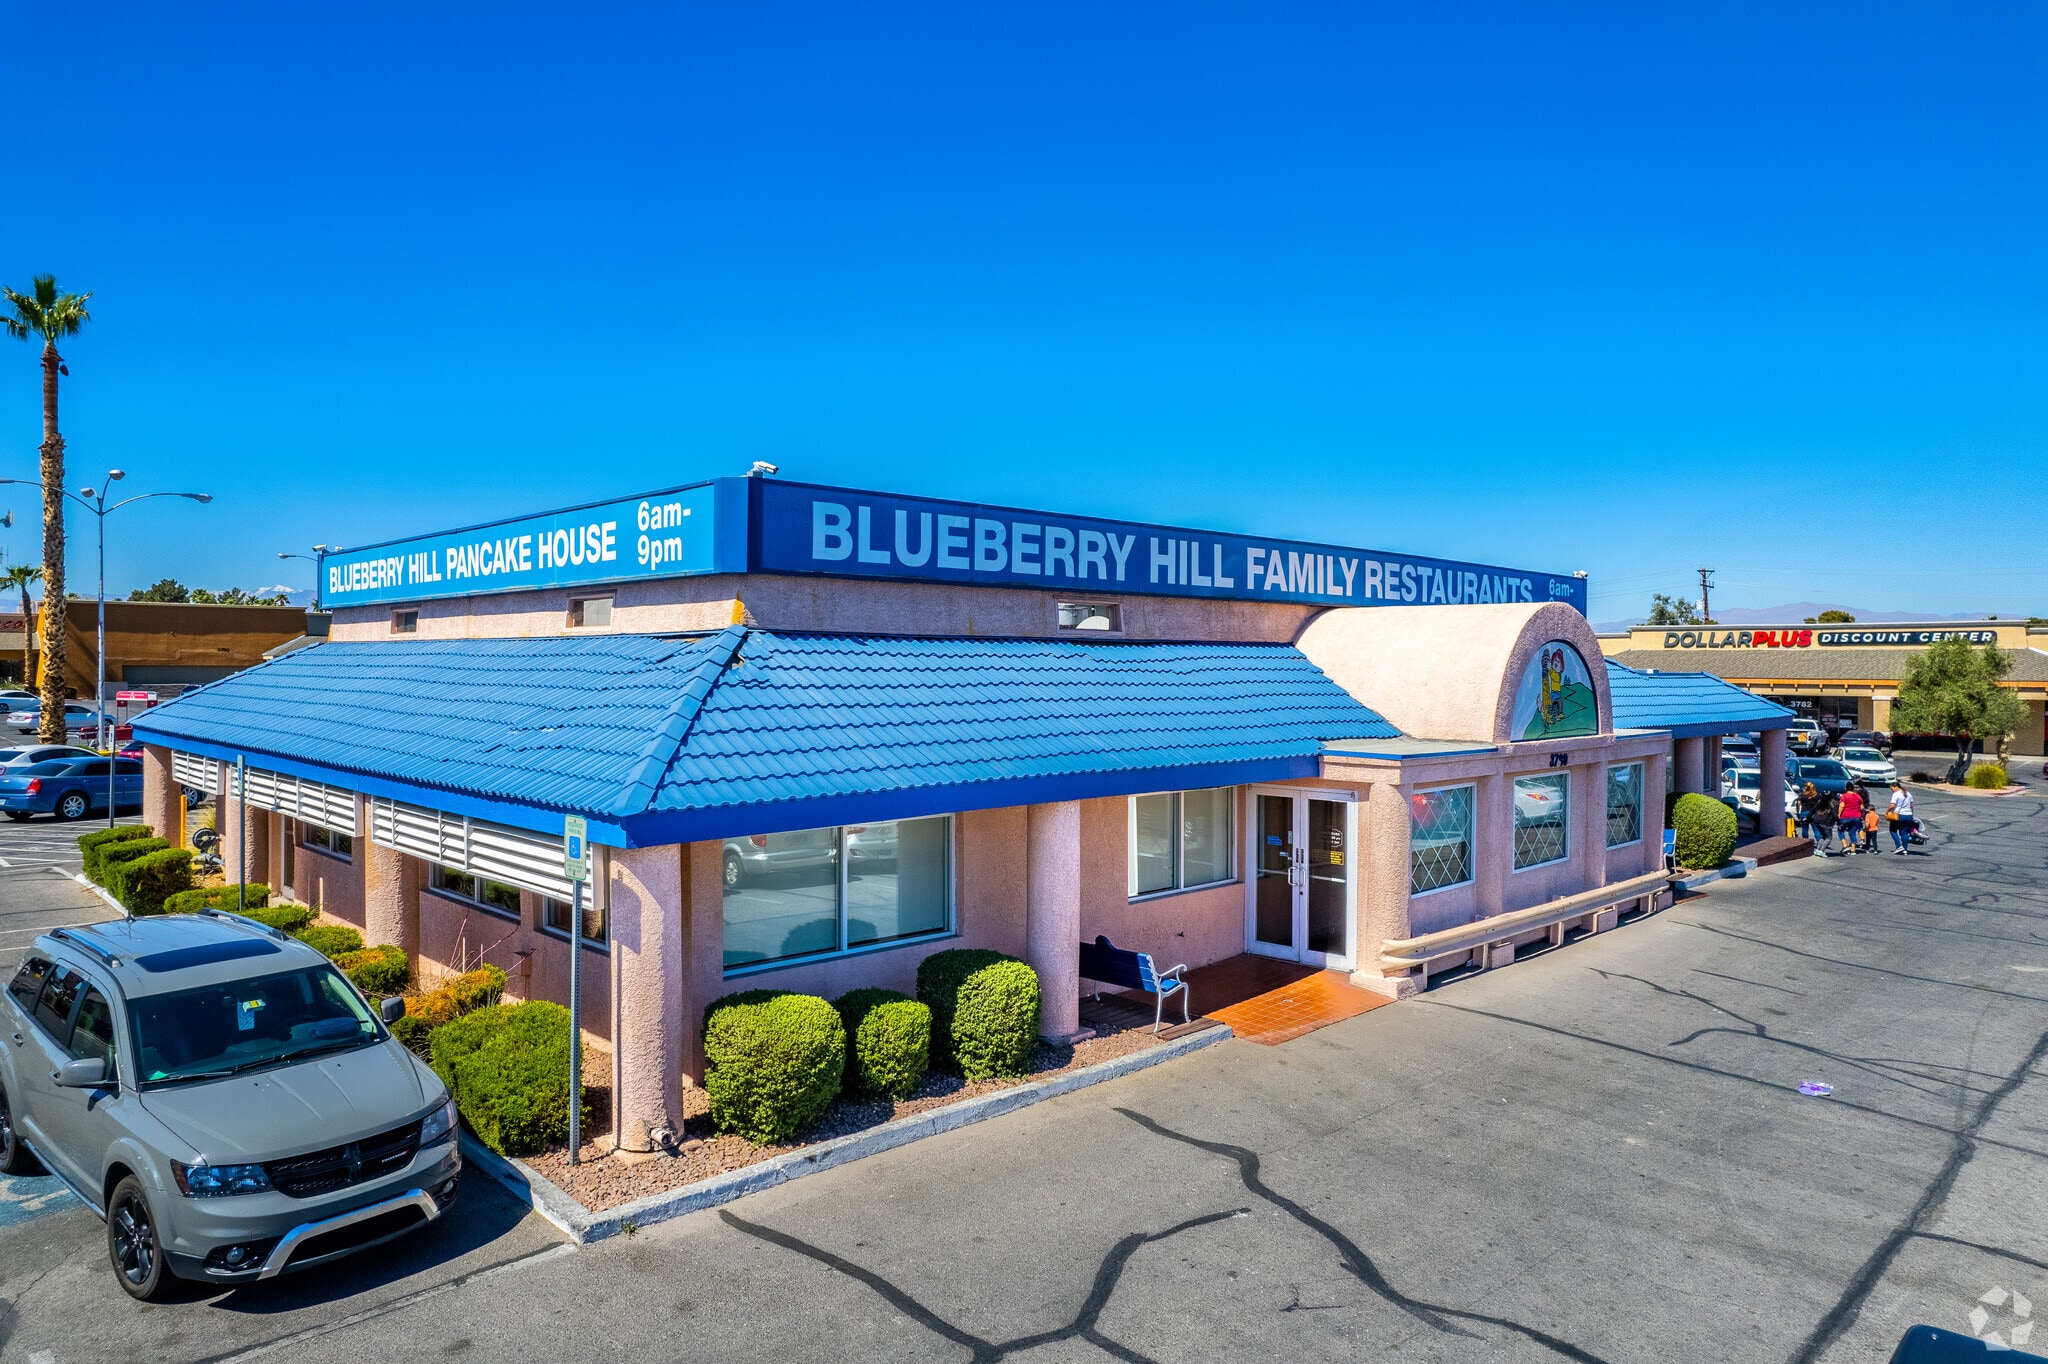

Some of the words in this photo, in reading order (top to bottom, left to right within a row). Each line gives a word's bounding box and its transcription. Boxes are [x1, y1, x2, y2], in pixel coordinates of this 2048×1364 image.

[637, 501, 691, 531] 6am-
[329, 555, 405, 593] BLUEBERRY
[408, 550, 442, 584] HILL
[446, 535, 532, 580] PANCAKE
[538, 521, 617, 569] HOUSE
[637, 535, 682, 570] 9pm
[812, 501, 1135, 581] BLUEBERRY
[1150, 538, 1234, 588] HILL
[1247, 547, 1359, 597] FAMILY
[1365, 559, 1532, 604] RESTAURANTS
[1549, 578, 1574, 597] 6am-
[1821, 633, 1911, 643] DISCOUNT
